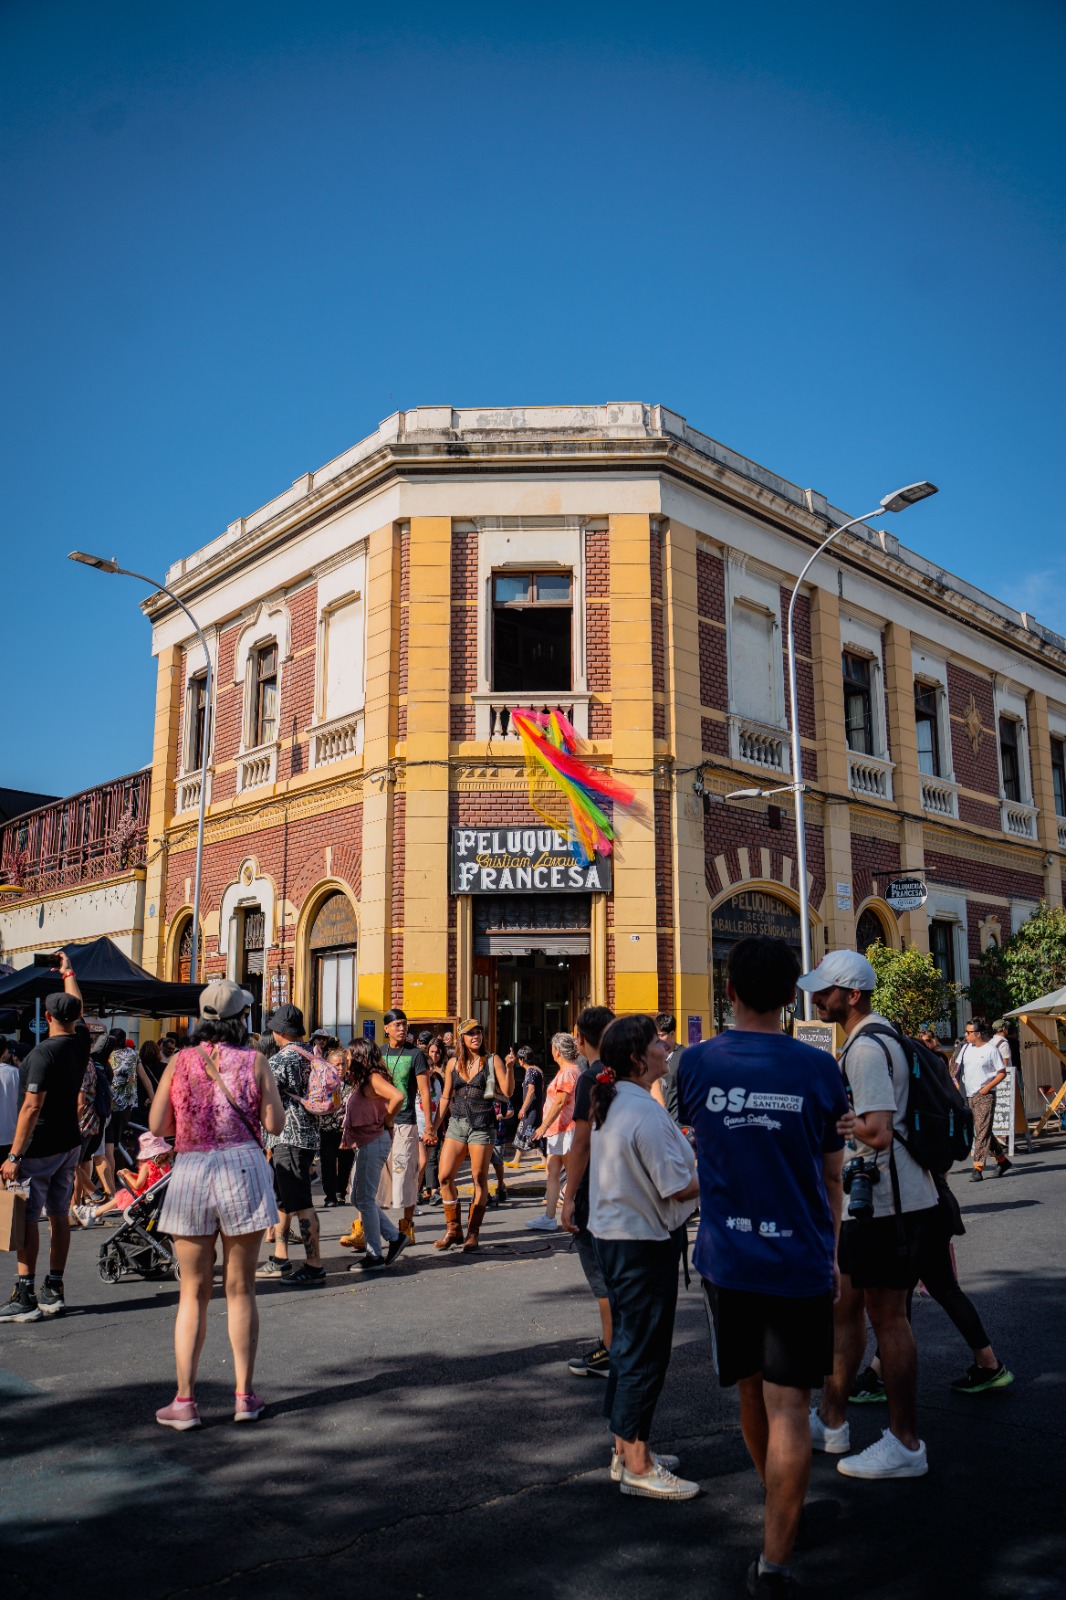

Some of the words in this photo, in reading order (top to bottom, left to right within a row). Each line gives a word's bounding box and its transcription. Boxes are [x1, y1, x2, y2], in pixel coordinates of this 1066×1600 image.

[457, 830, 575, 856] PELUQUE
[458, 861, 602, 891] FRANCESA
[706, 1087, 746, 1112] GS
[752, 1100, 800, 1111] SANTIAGO
[753, 1094, 789, 1102] GOBIERNO
[790, 1096, 800, 1104] DE
